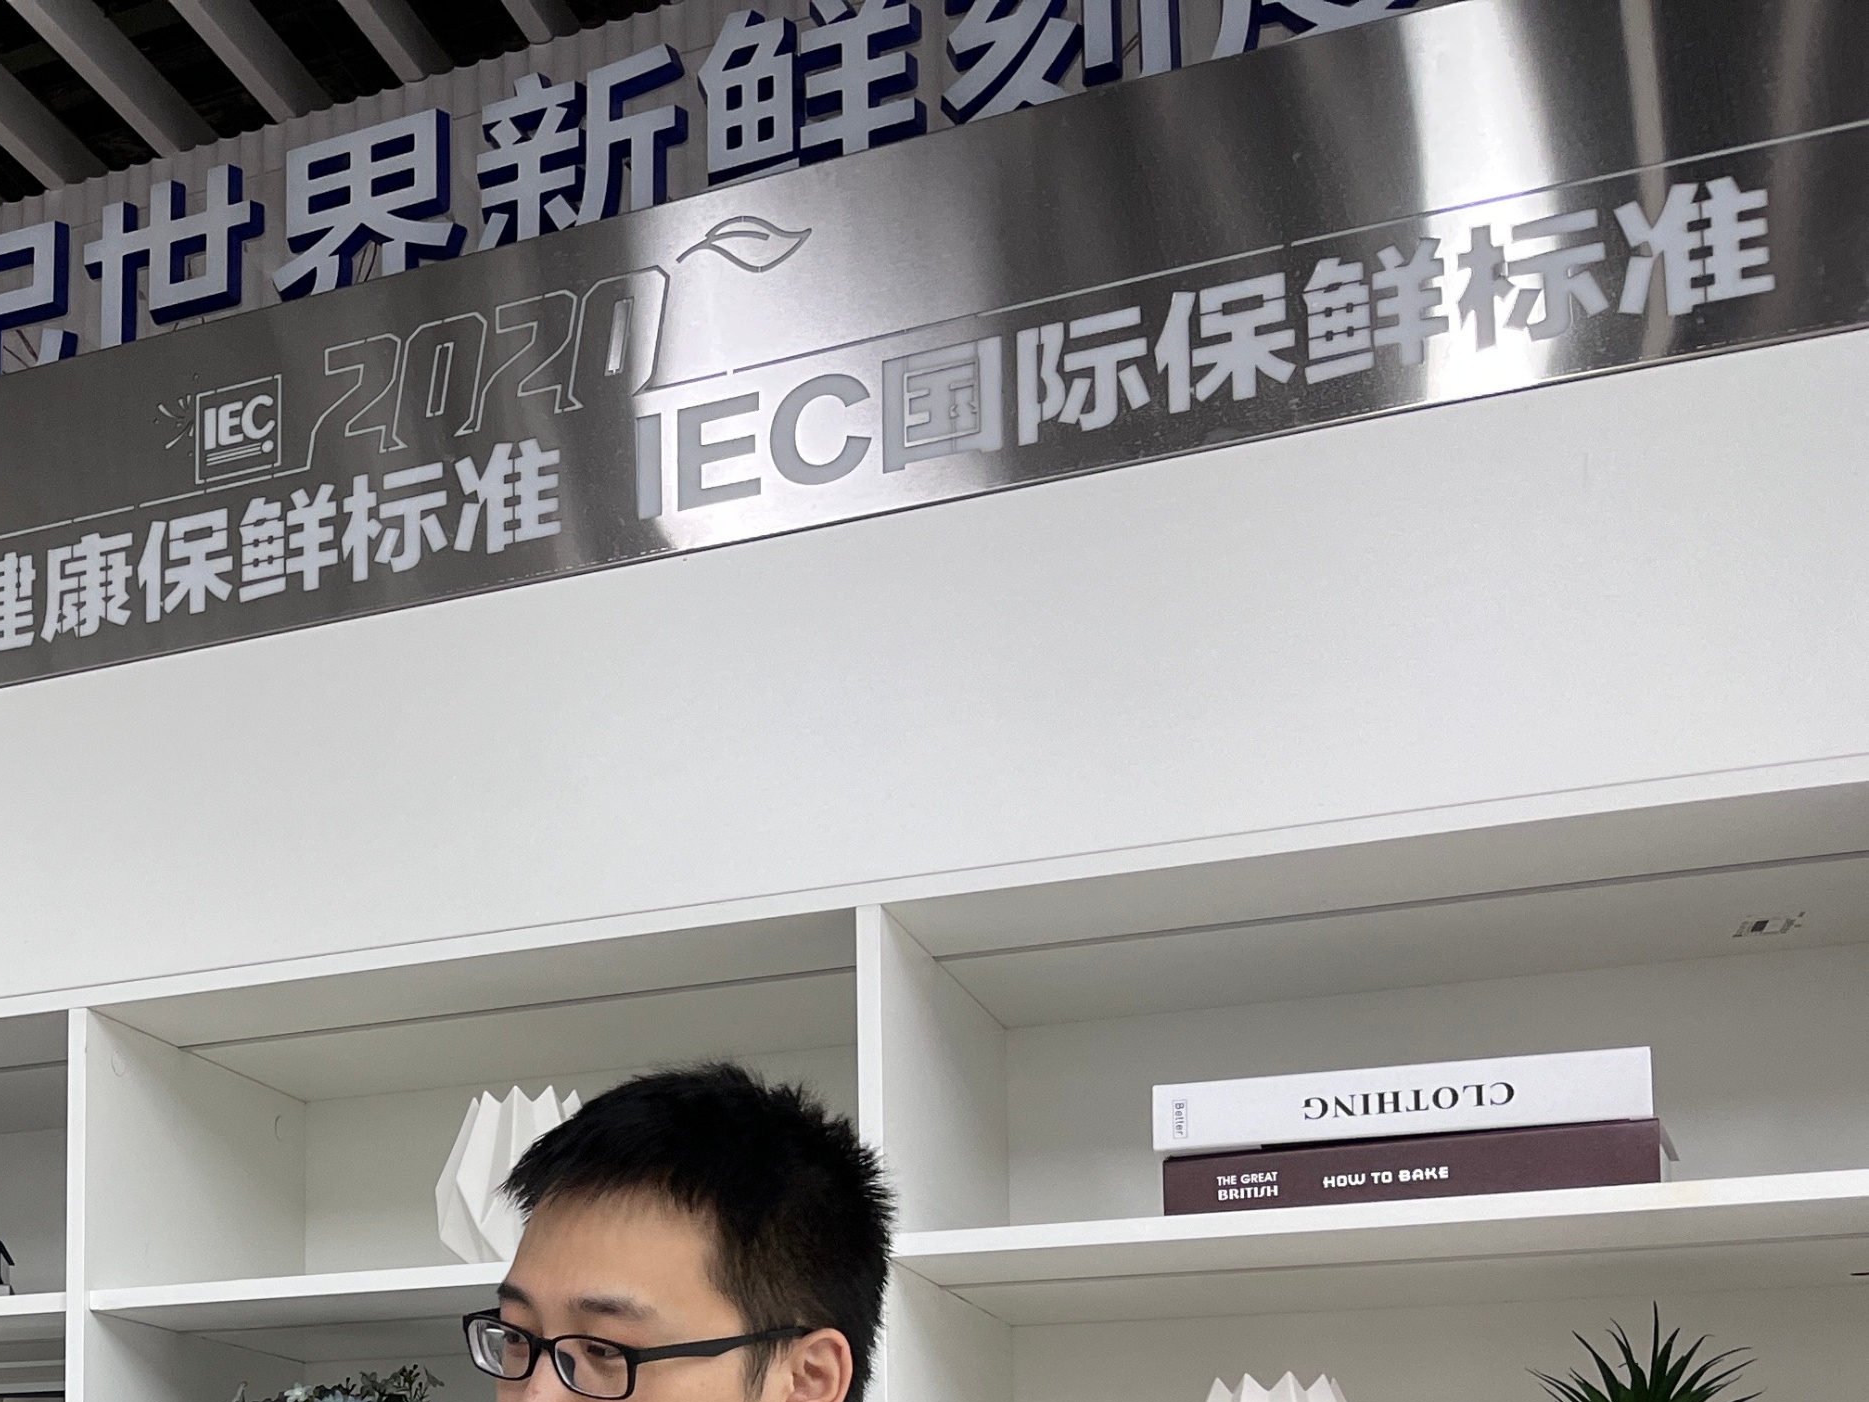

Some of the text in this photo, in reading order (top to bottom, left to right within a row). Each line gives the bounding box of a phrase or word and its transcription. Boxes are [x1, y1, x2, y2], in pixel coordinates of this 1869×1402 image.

[634, 175, 1776, 521] IEC国际保鲜标准
[307, 264, 671, 472] 2020
[202, 394, 277, 450] IEC
[1173, 1101, 1185, 1136] Better
[1303, 1080, 1516, 1122] CLOTHING
[1216, 1171, 1279, 1186] THE GREAT
[1217, 1184, 1279, 1201] BRITISH
[1322, 1166, 1450, 1189] HOW TO BAKE
